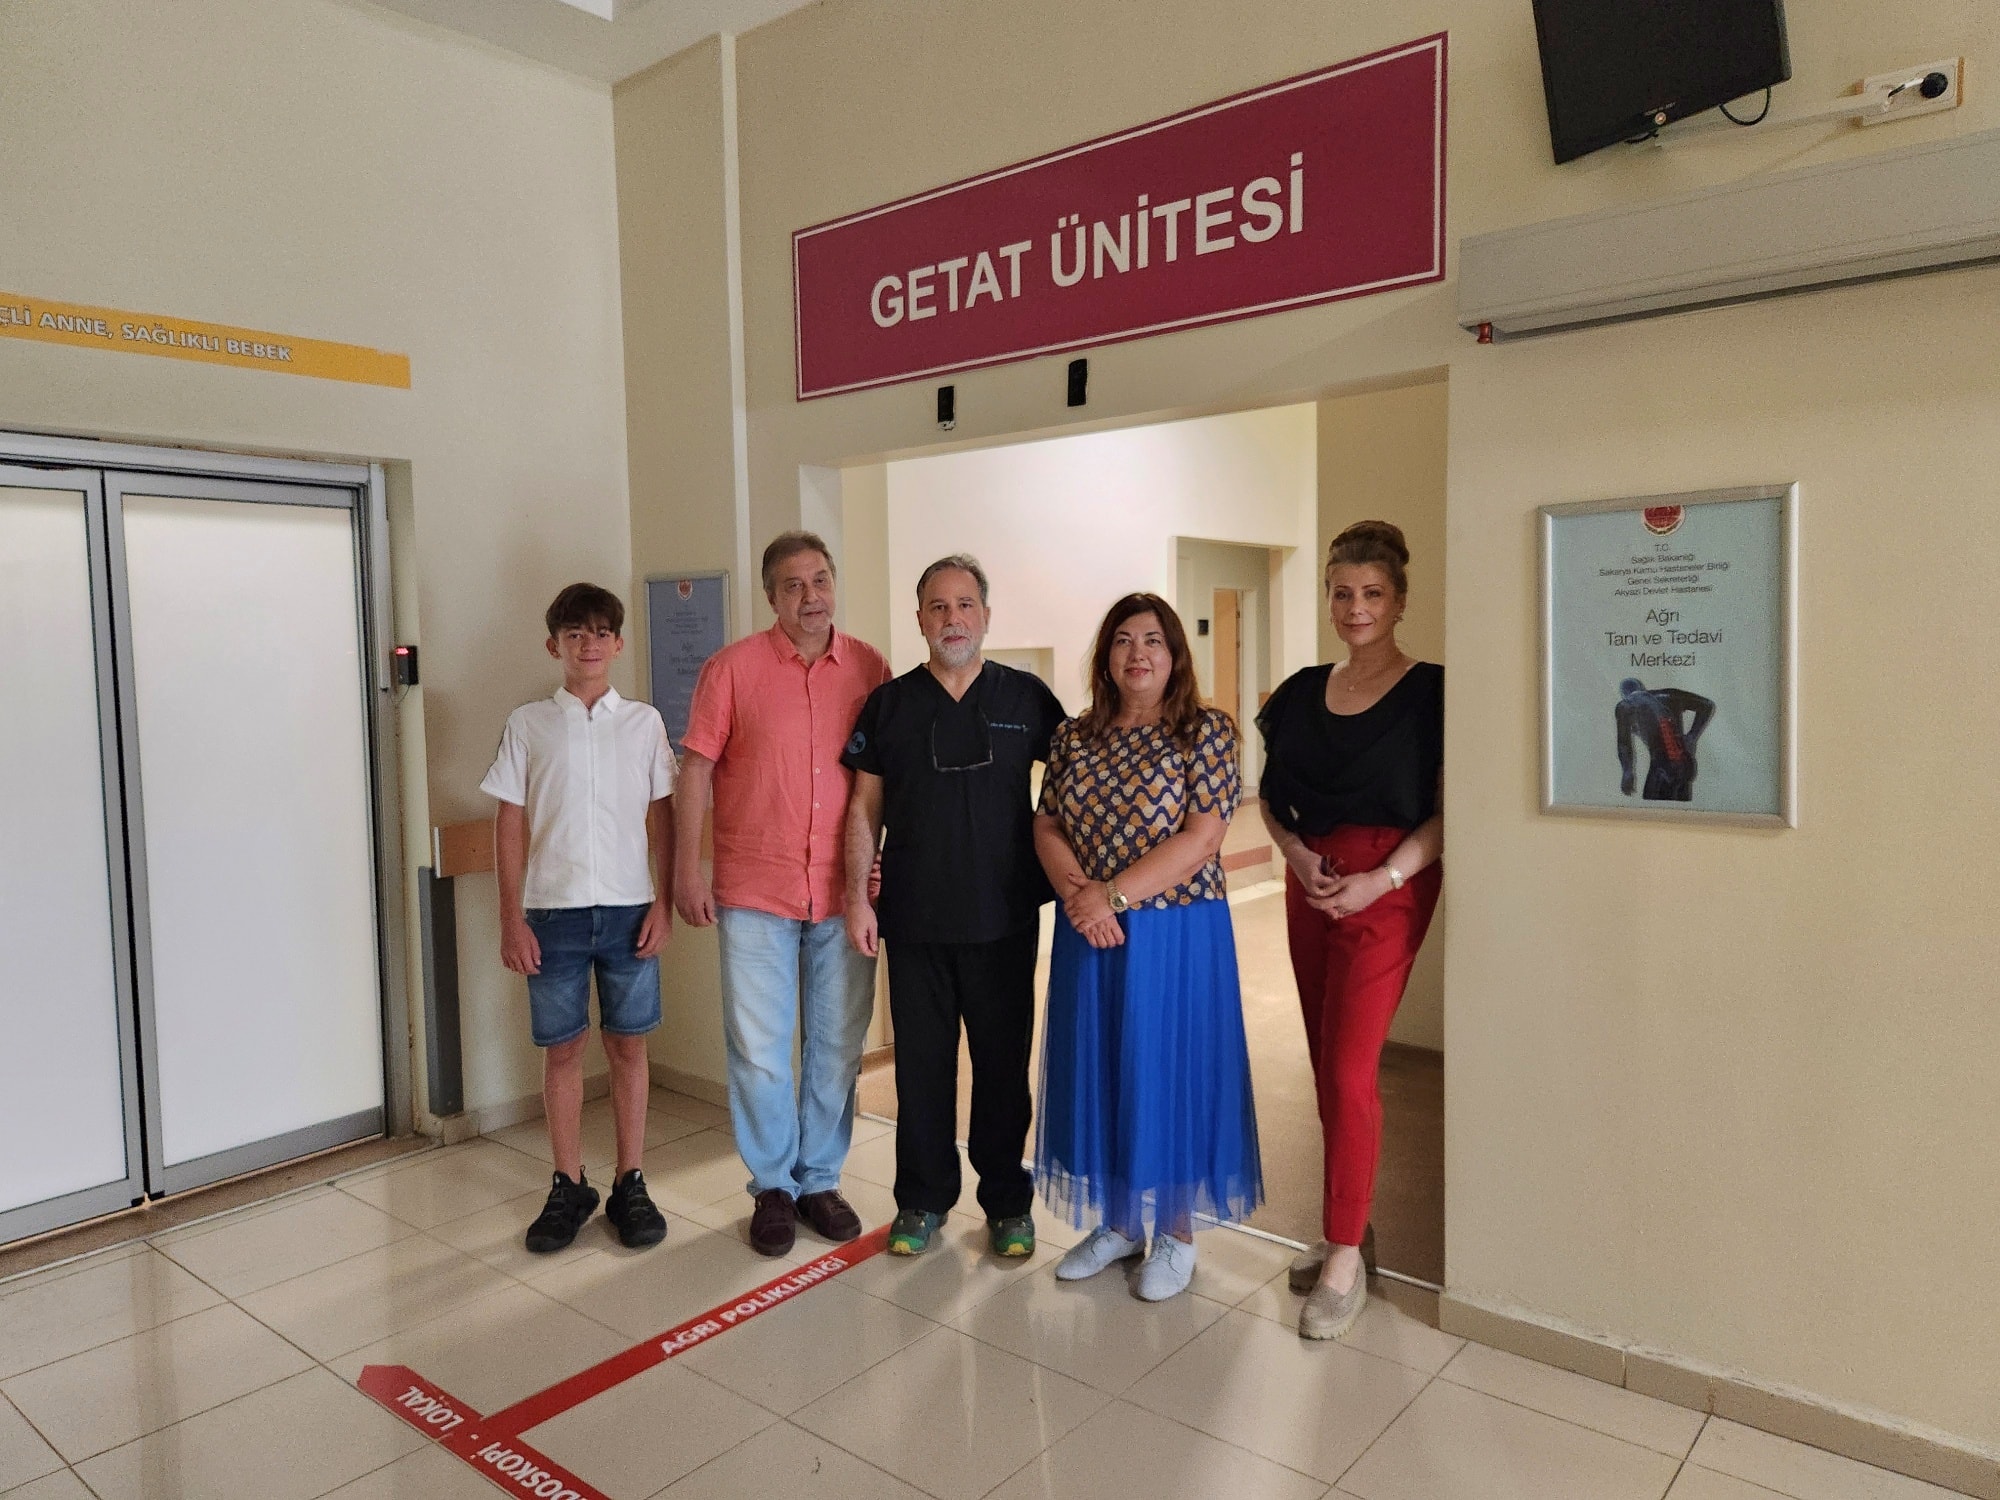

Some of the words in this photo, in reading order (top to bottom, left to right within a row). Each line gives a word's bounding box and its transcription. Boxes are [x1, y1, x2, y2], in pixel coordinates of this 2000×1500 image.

[869, 239, 1033, 329] GETAT
[1050, 151, 1305, 288] ÜNİTESİ
[38, 312, 113, 339] ANNE,
[121, 322, 220, 352] SAĞLIKLI
[226, 337, 293, 362] BEBEK
[1604, 631, 1638, 647] Tanı
[1643, 633, 1662, 646] ve
[1666, 629, 1723, 645] Tedavi
[1645, 608, 1680, 627] Ağrı
[1631, 651, 1696, 668] Merkezi
[660, 1319, 723, 1354] AĞRI
[719, 1255, 849, 1323] POLİKLİNİĞİ
[396, 1385, 465, 1431] LOKAL
